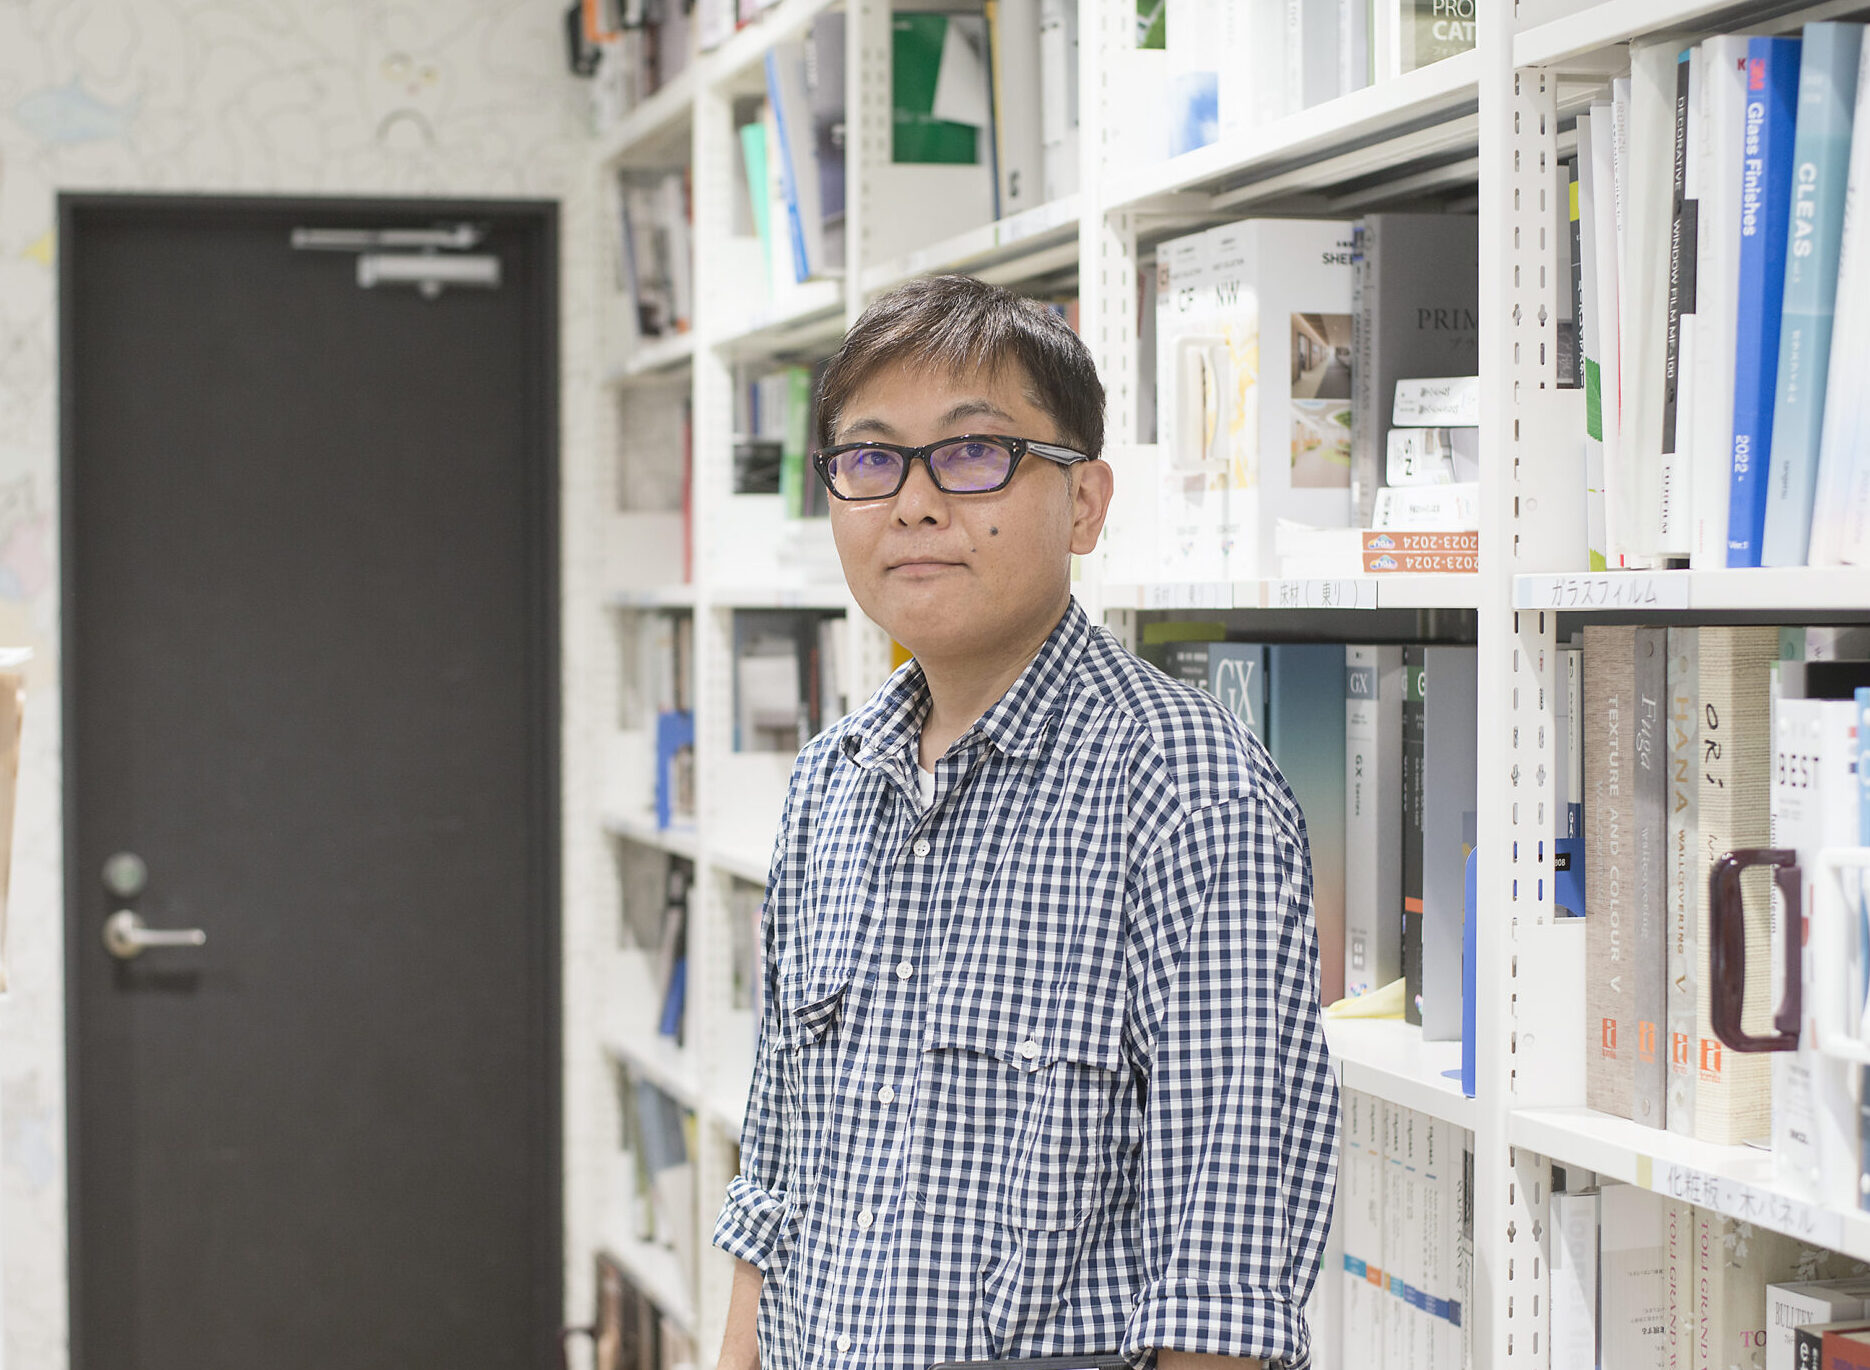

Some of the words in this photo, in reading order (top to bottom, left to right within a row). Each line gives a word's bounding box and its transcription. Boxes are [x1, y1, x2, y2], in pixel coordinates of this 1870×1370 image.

[1432, 20, 1475, 41] CAT
[1748, 58, 1765, 90] 3M
[1674, 96, 1685, 191] DECORATIVE
[1746, 102, 1765, 155] Glass
[1742, 158, 1763, 237] Finishes
[1793, 162, 1818, 258] CLEAS
[1670, 219, 1681, 285] WINDOW
[1668, 287, 1678, 323] FILM
[1552, 580, 1657, 607] ガラスフィルム
[1349, 672, 1368, 695] GX
[1608, 693, 1620, 797] TEXTURE
[1635, 692, 1657, 772] Fuga
[1674, 696, 1690, 814] HANA
[1608, 807, 1620, 855] AND
[1609, 865, 1620, 961] COLOUR
[1676, 829, 1686, 955] WALLCOVERING
[1609, 975, 1621, 993] V
[1674, 974, 1687, 993] V
[1669, 1208, 1677, 1261] TOLI
[1700, 1219, 1709, 1272] TOLI
[1669, 1266, 1677, 1346] GRAND
[1700, 1277, 1709, 1359] GRAND
